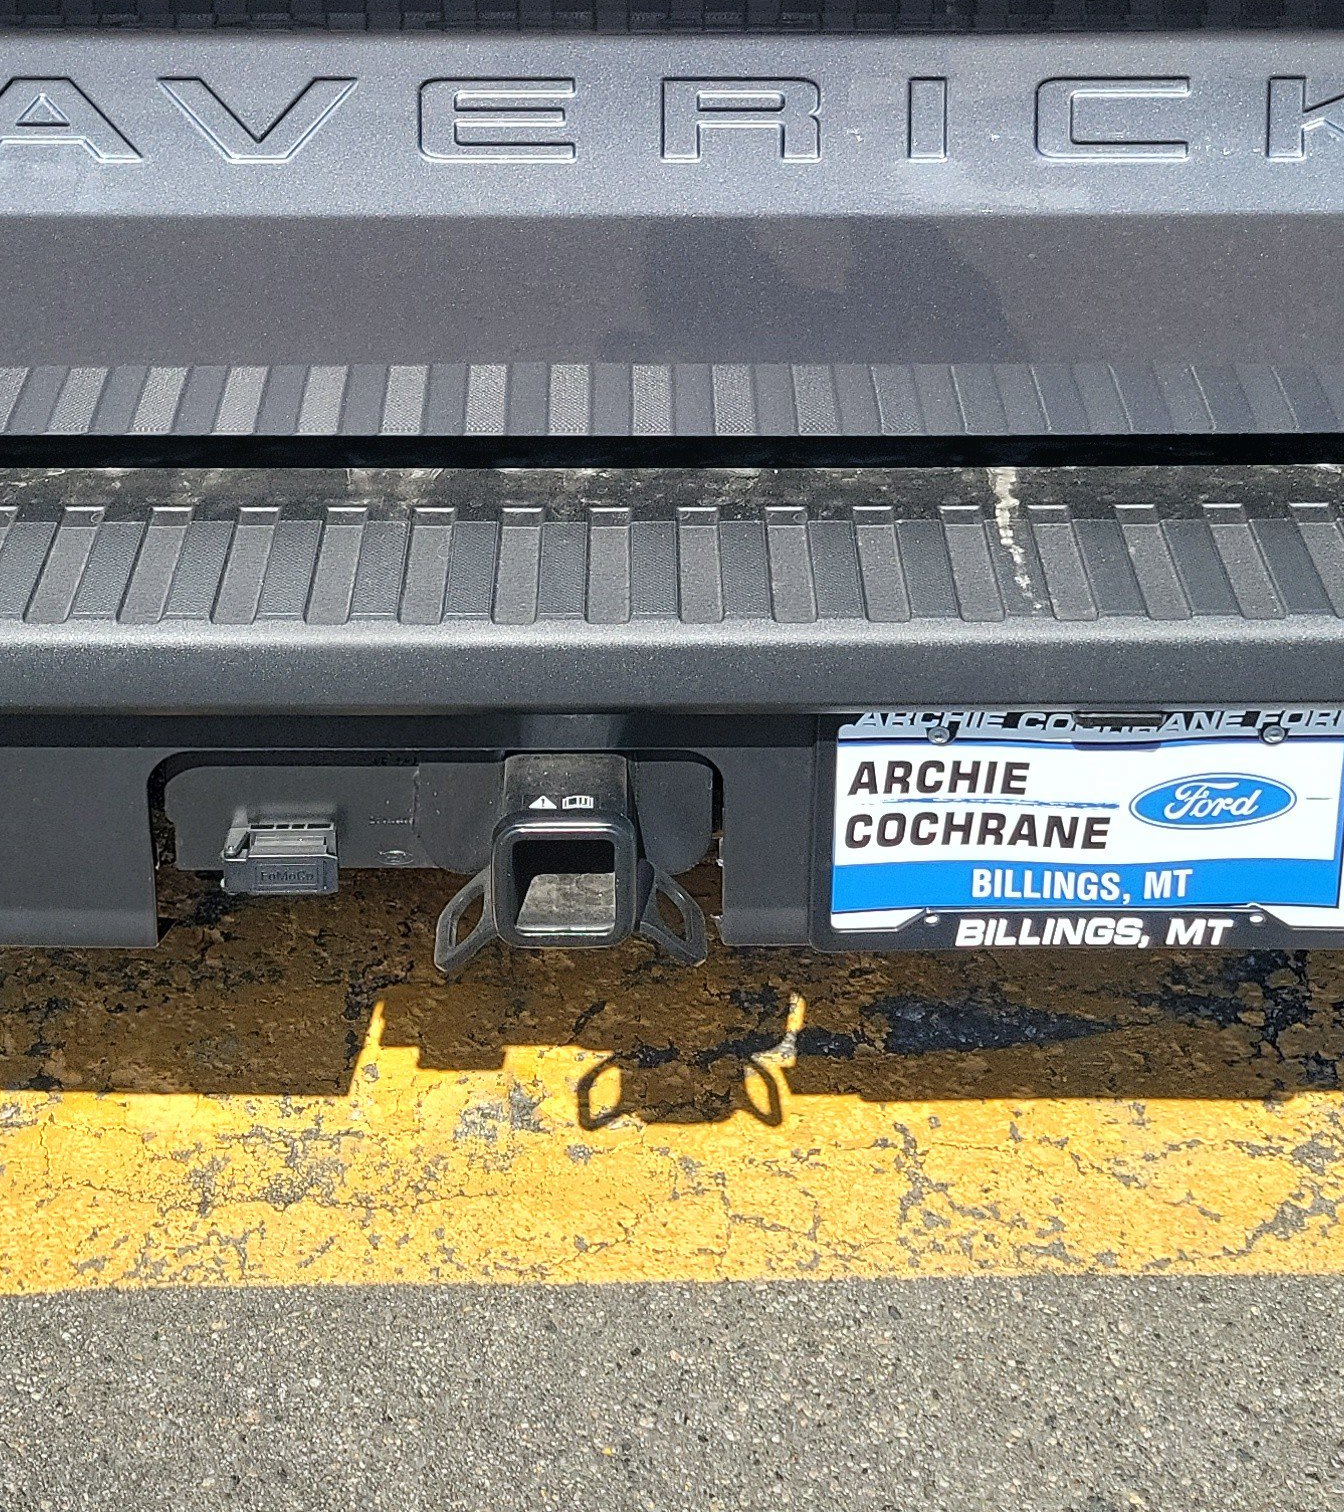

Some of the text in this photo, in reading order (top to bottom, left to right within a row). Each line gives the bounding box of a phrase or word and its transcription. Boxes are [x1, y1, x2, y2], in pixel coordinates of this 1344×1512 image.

[846, 759, 1031, 796] ARCHIE
[1163, 781, 1263, 820] Ford
[844, 812, 1112, 851] COCHRANE
[970, 866, 1193, 905] BILLINGS, MT
[955, 916, 1234, 949] BILLINGS, MT
